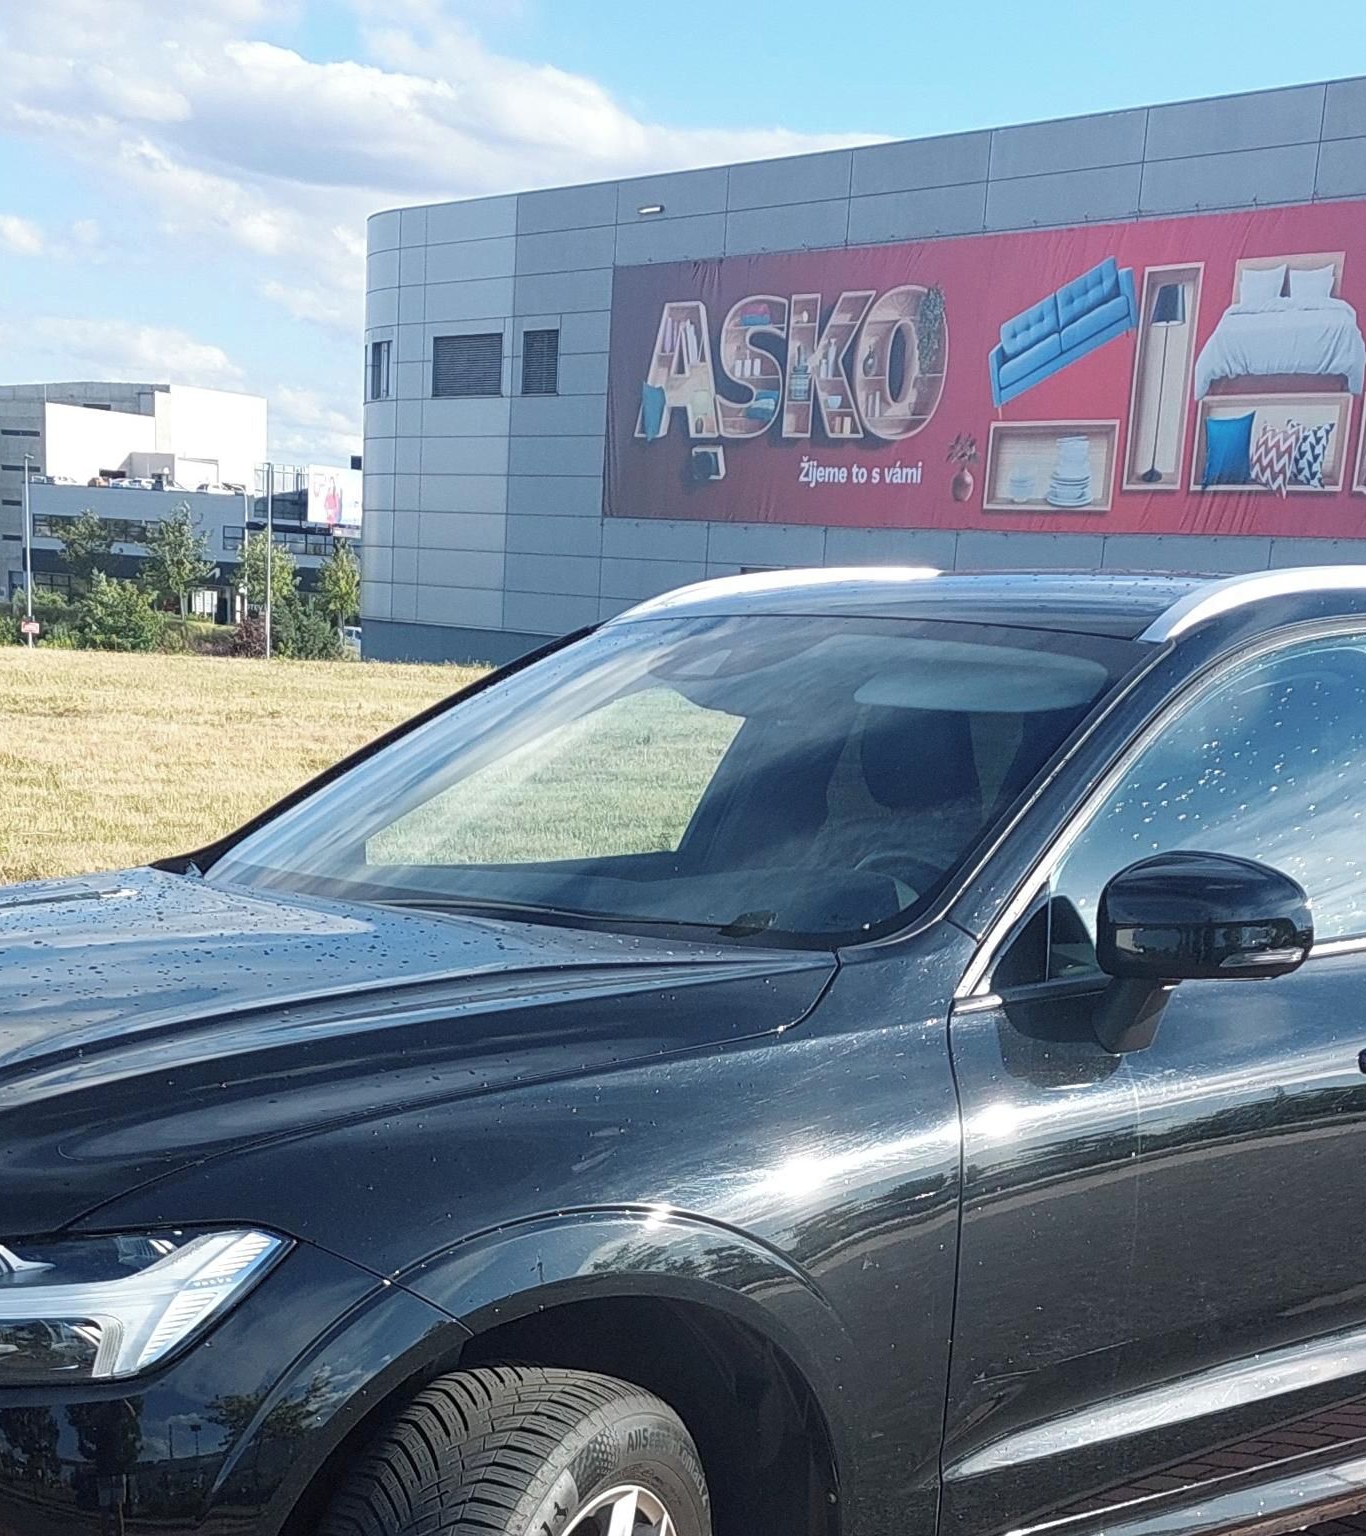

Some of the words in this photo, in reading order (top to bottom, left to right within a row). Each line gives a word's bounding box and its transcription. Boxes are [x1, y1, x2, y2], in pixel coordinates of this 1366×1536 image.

[634, 282, 949, 441] ASKO
[798, 456, 848, 488] Žijeme
[851, 464, 868, 484] to
[871, 467, 881, 484] s
[884, 461, 923, 484] vámi
